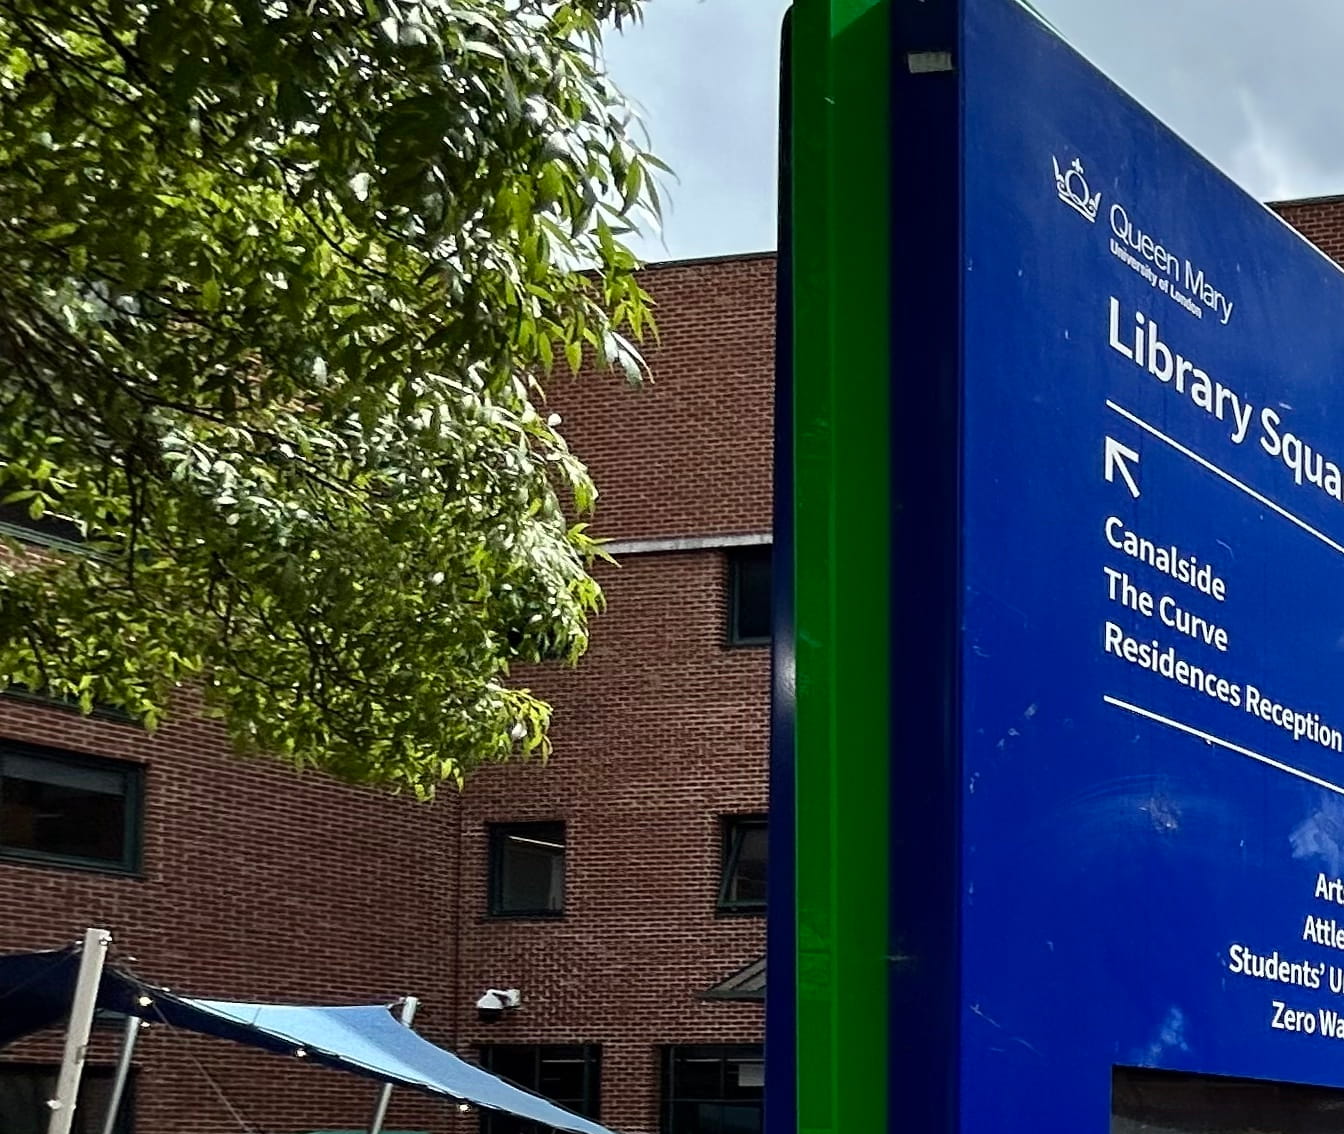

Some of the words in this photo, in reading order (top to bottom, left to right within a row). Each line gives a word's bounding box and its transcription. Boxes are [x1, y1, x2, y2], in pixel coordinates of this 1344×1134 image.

[1110, 204, 1179, 281] Queen
[1185, 259, 1233, 325] Mary
[1110, 238, 1158, 287] University
[1158, 278, 1169, 293] of
[1169, 284, 1202, 319] London
[1109, 296, 1253, 443] Library
[1105, 516, 1226, 601] Canalside
[1104, 566, 1153, 617] The
[1159, 596, 1228, 652] Curve
[1105, 621, 1241, 707] Residences
[1246, 685, 1343, 753] Reception
[1271, 1000, 1316, 1034] Zero
